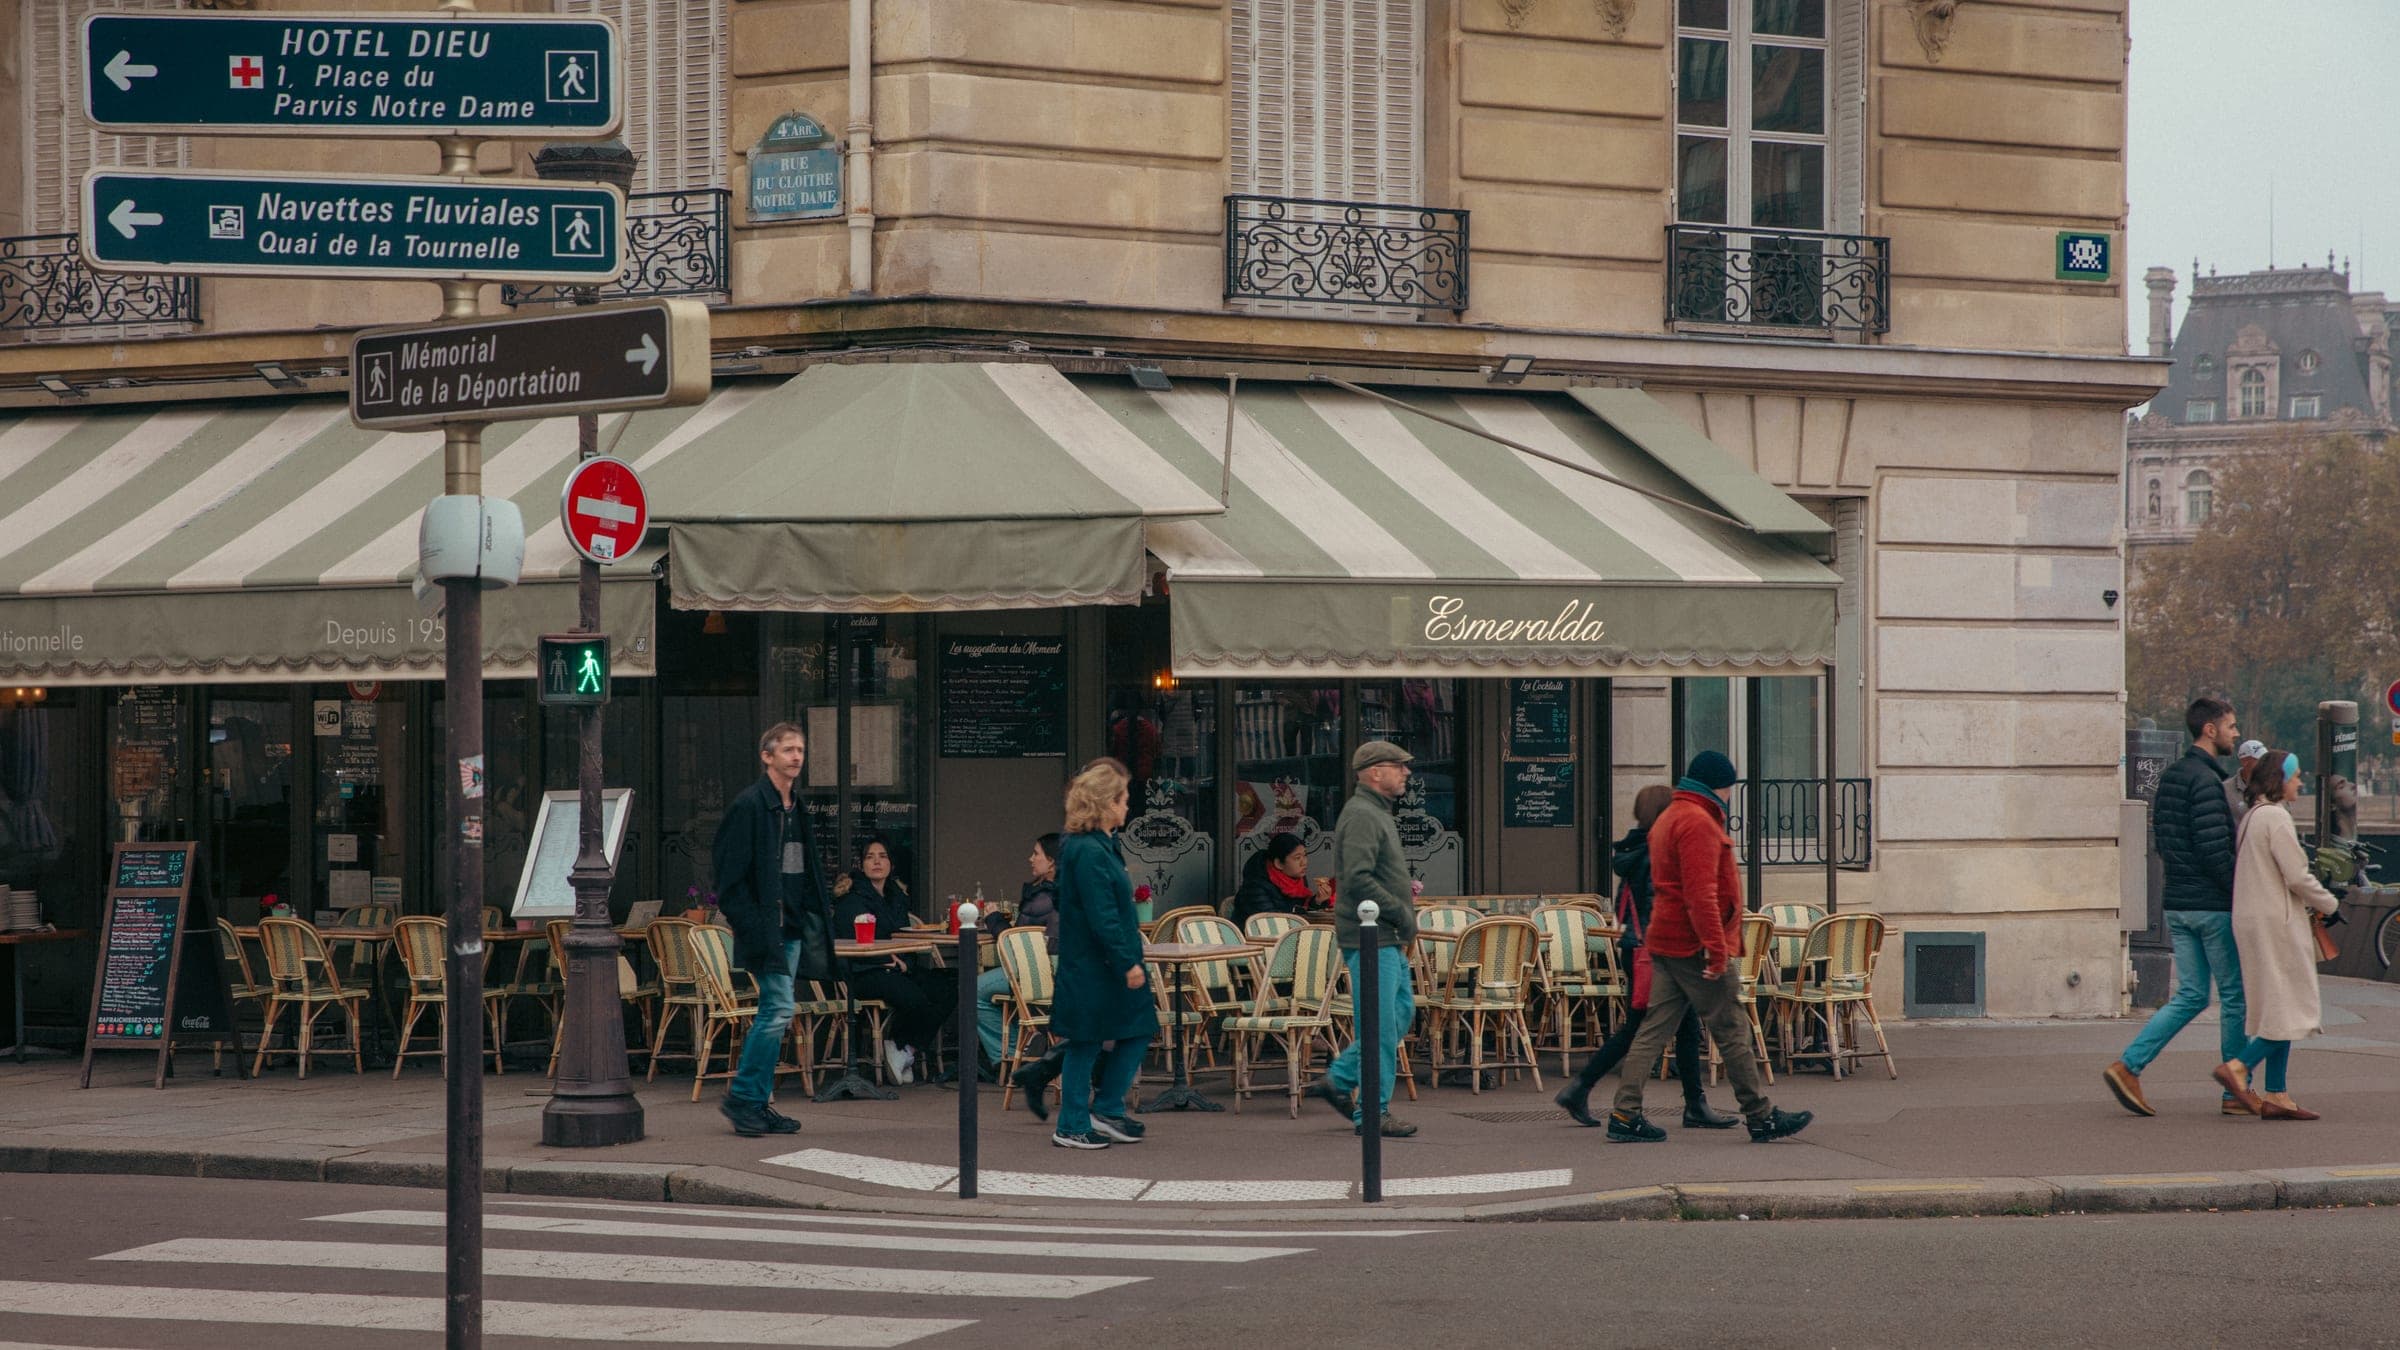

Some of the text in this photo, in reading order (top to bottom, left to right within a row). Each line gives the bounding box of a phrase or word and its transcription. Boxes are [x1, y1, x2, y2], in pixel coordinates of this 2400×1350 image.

[280, 28, 490, 58] HOTEL DIEU
[314, 64, 390, 88] Place
[403, 64, 435, 87] du
[273, 93, 535, 118] Parvis Notre Dame
[780, 156, 809, 171] RUE
[756, 171, 834, 190] DU CLOÎTRE
[256, 192, 540, 226] Navettes Fluviales
[753, 190, 837, 208] NOTRE DAME
[258, 230, 520, 260] Quai de la Tournelle
[400, 334, 497, 371] Mémorial
[400, 368, 580, 407] de la Déportation
[1424, 595, 1605, 642] Esmeralda
[326, 618, 446, 650] Depuis 195
[949, 641, 1062, 657] Les suggestions du Moment
